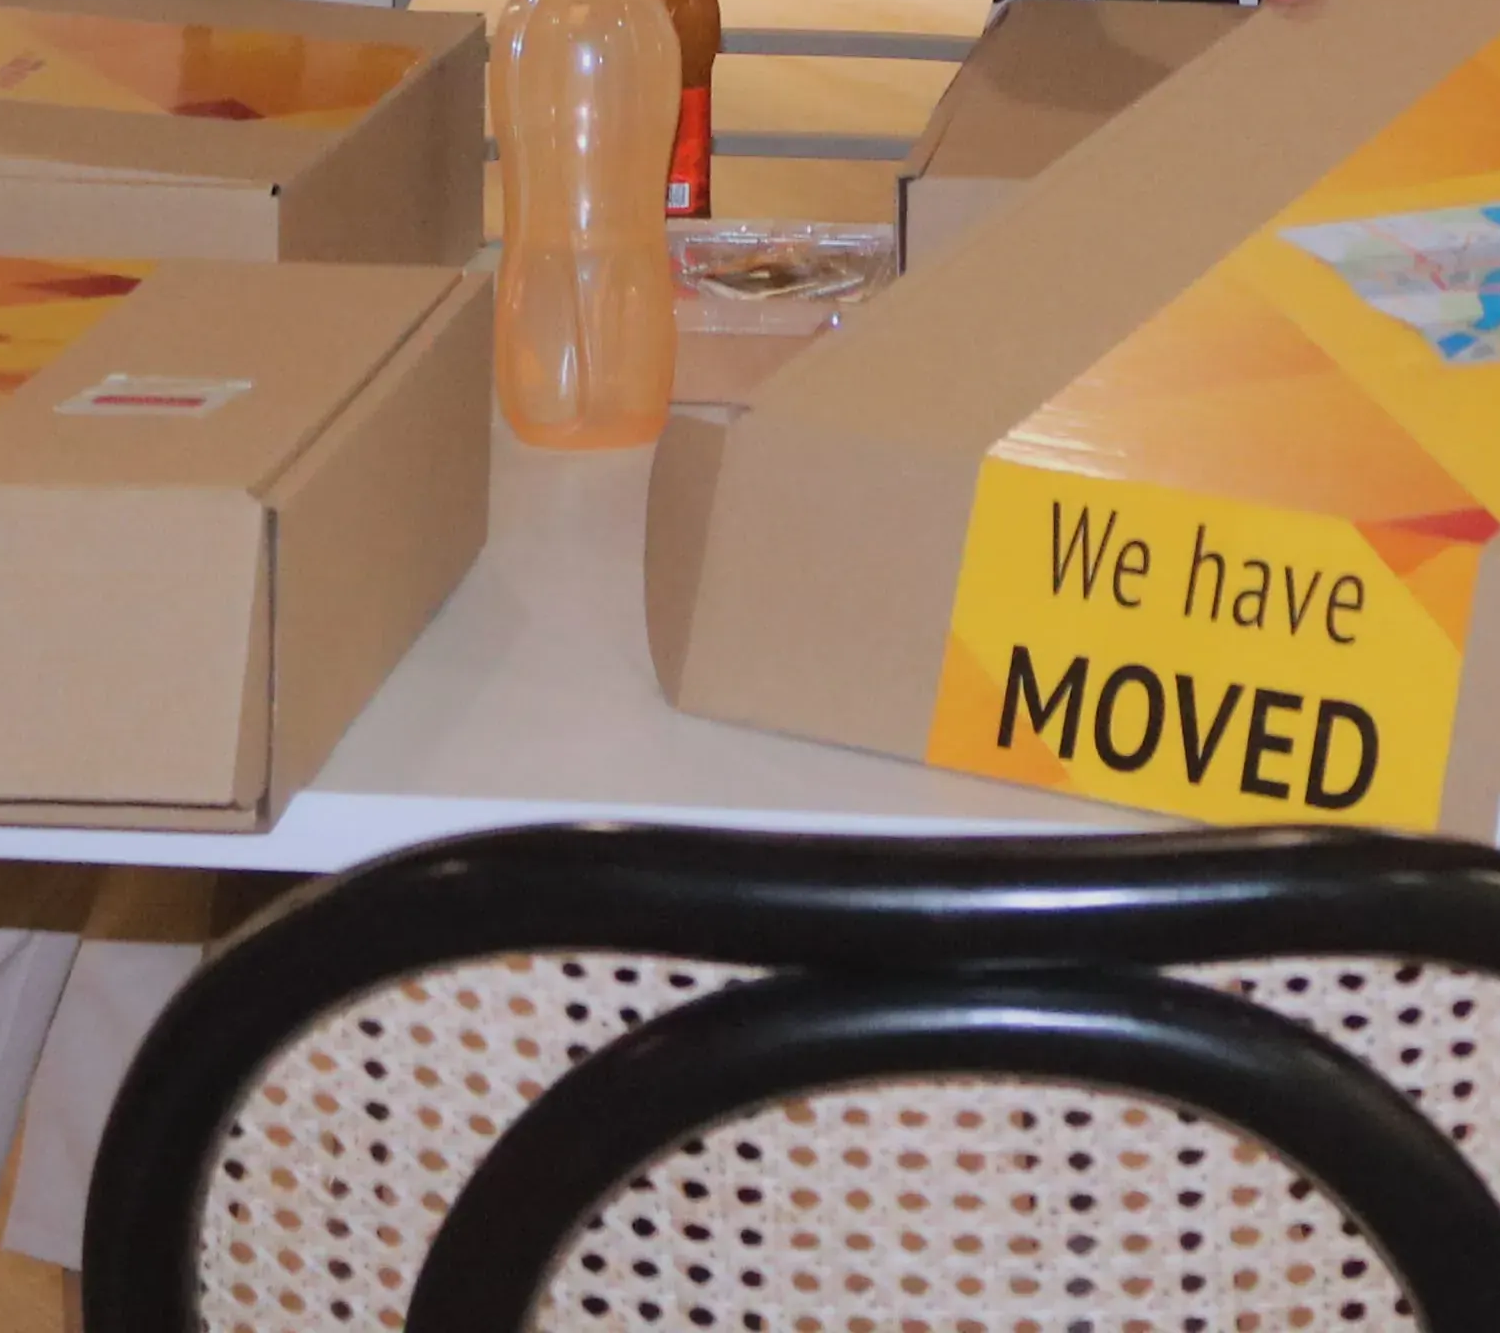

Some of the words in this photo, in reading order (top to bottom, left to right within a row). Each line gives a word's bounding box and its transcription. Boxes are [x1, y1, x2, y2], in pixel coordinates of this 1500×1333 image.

[1052, 501, 1150, 608] We
[1184, 526, 1364, 644] have
[998, 645, 1380, 811] MOVED
